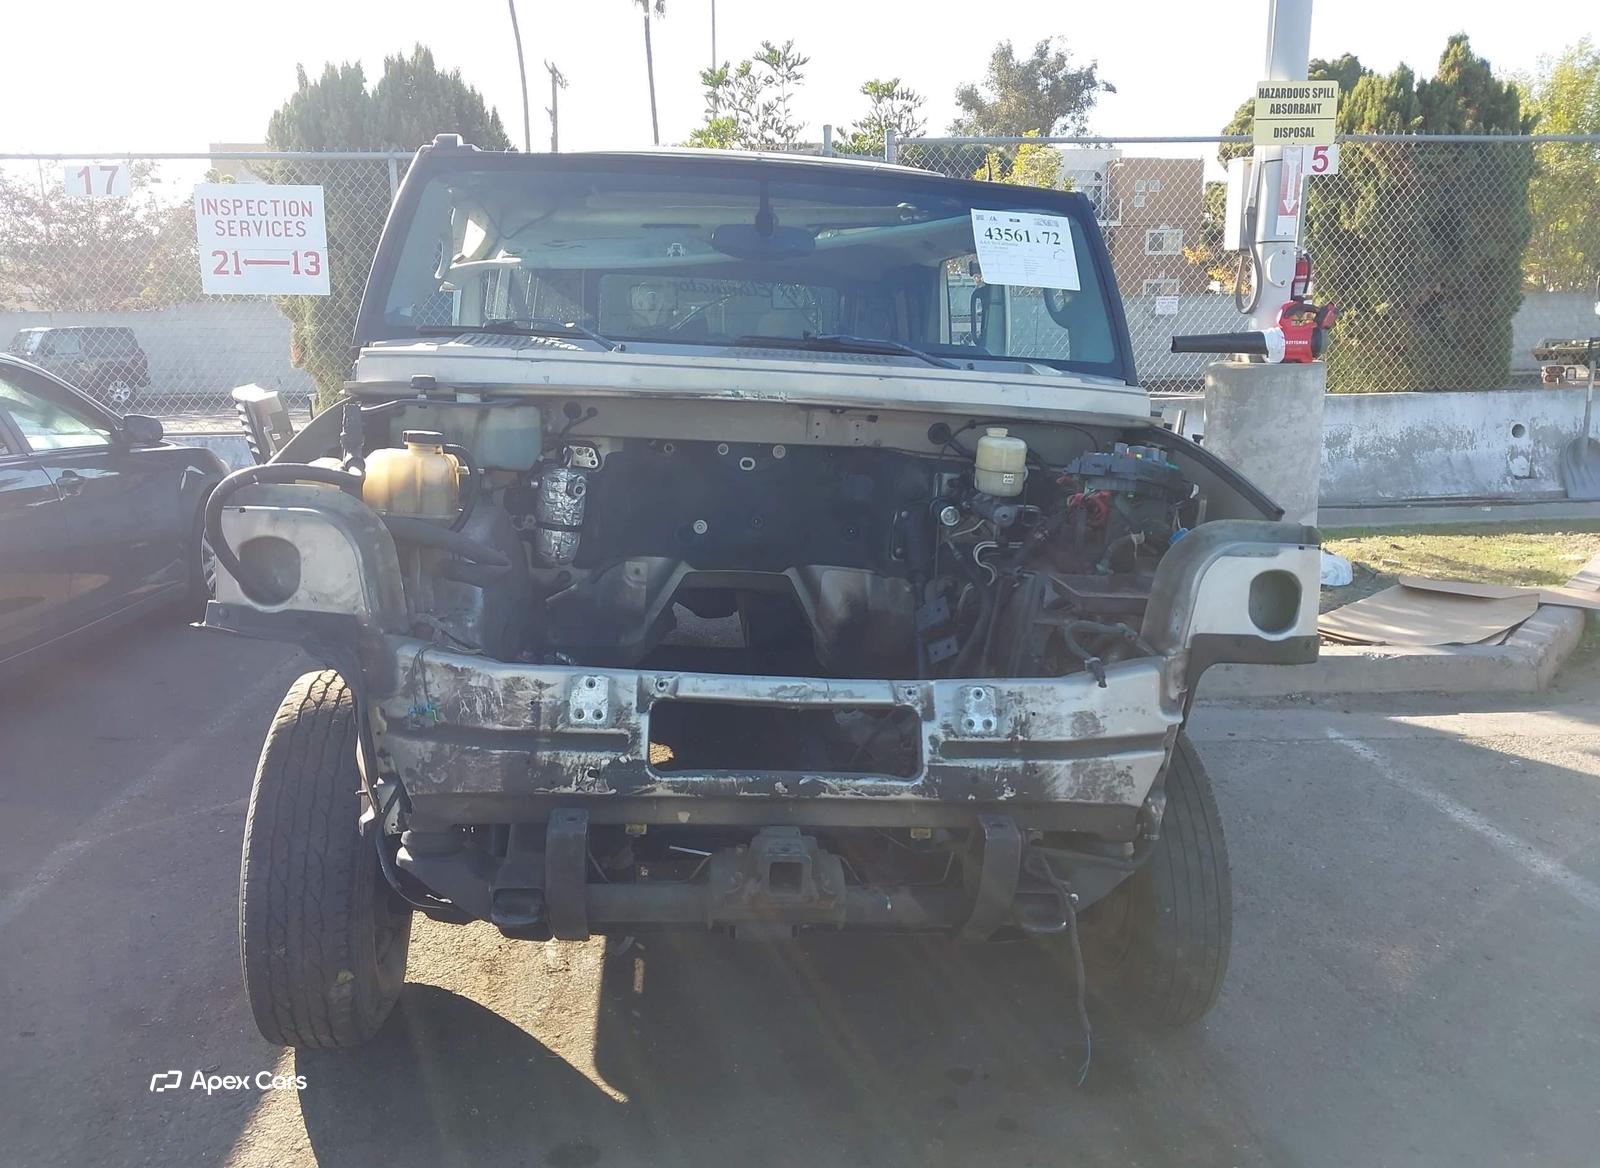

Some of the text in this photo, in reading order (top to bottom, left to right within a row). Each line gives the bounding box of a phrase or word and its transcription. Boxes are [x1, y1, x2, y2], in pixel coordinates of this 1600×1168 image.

[1258, 87, 1335, 99] HAZARDOUS SPILL
[1269, 103, 1322, 115] ABSORBANT
[1273, 127, 1315, 138] DISPOSAL
[1311, 146, 1330, 173] 5
[77, 165, 119, 195] 17
[201, 199, 313, 217] INSPECTION
[215, 219, 307, 237] SERVICES
[211, 250, 321, 276] 21 13
